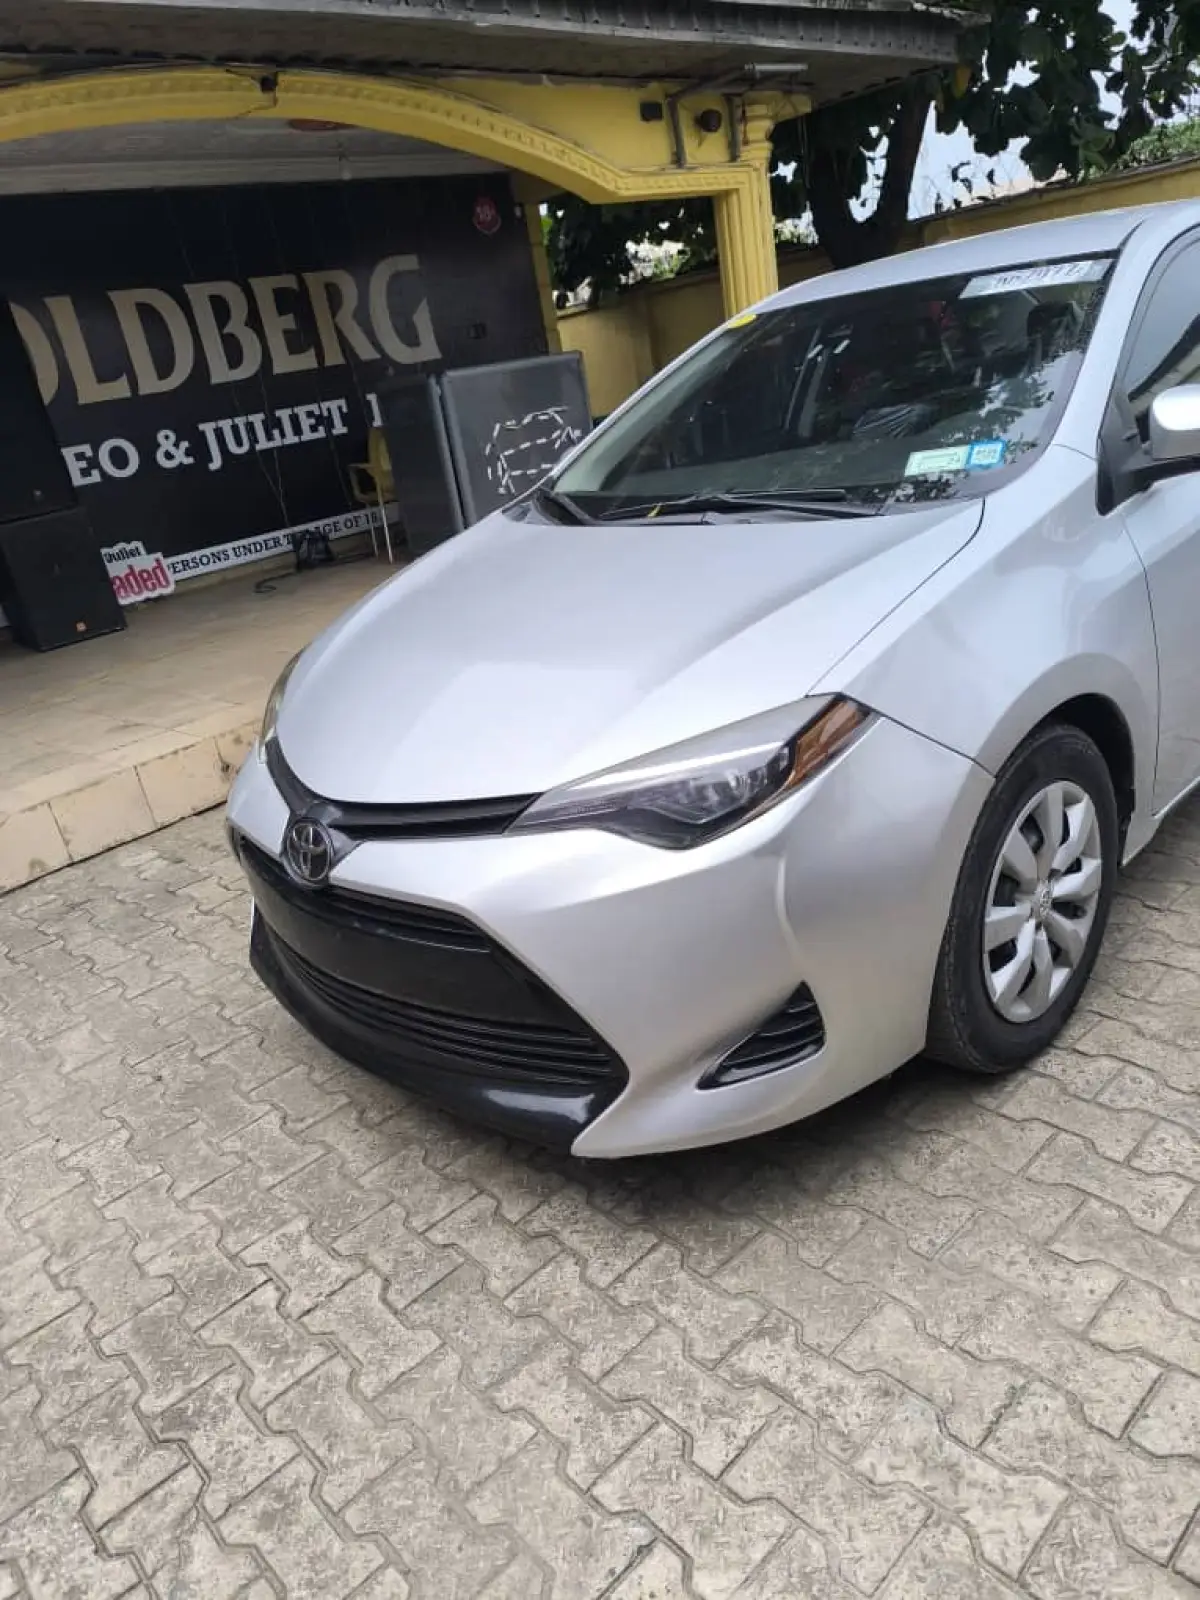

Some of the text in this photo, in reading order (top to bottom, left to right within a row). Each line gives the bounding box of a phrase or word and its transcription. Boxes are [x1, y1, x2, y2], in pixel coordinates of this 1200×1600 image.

[155, 429, 194, 470] &
[199, 398, 349, 472] JULIET
[167, 550, 231, 575] ERSONS
[231, 535, 283, 558] UNDER
[343, 514, 362, 530] OF
